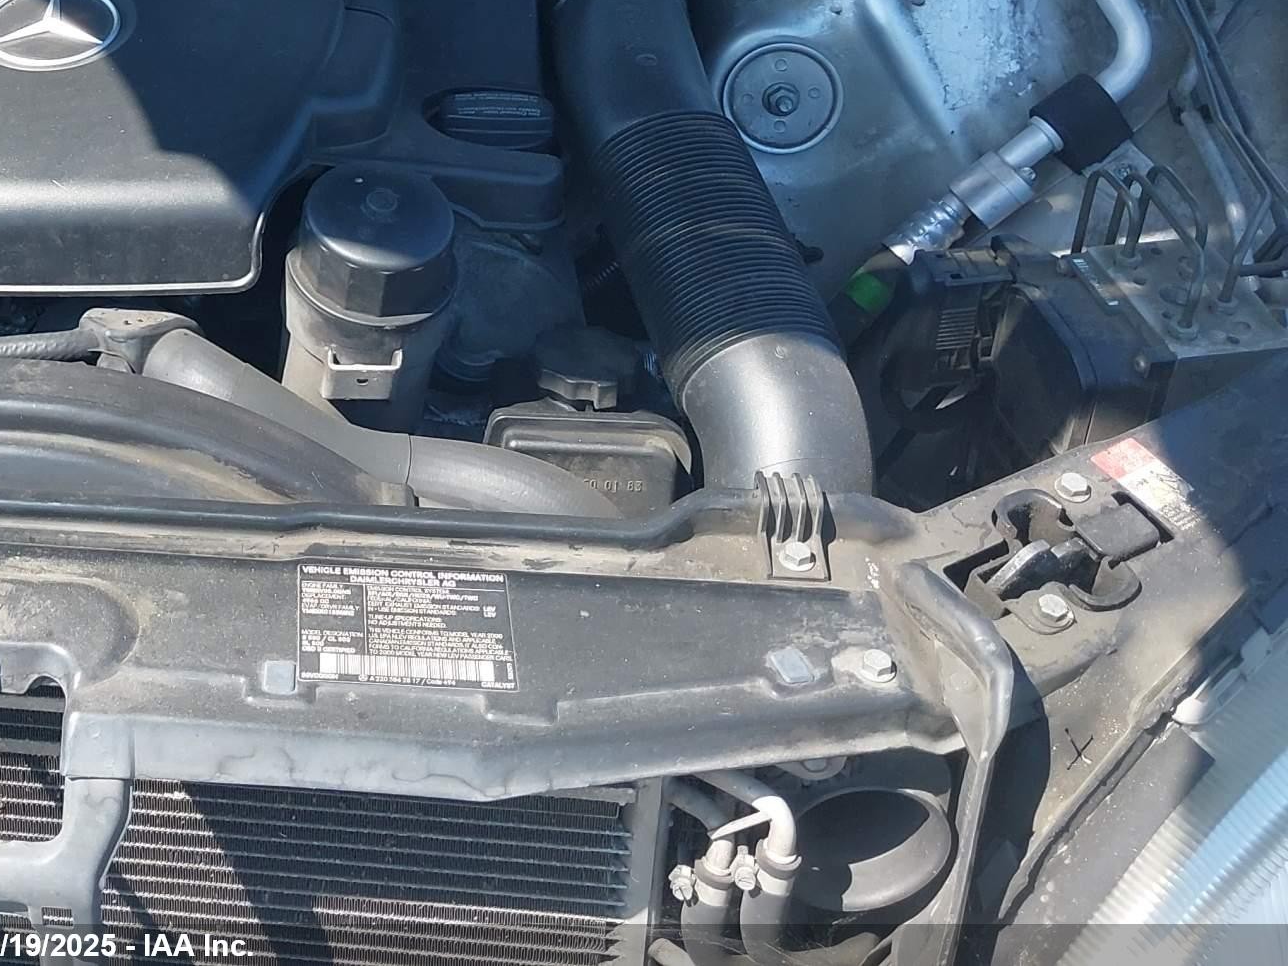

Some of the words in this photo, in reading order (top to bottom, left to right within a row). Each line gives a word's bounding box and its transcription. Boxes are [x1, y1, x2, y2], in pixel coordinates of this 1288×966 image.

[302, 566, 341, 574] VEHICLE
[343, 567, 389, 577] EMISSION
[390, 570, 436, 579] CONTROL
[438, 572, 504, 582] INFORMATION
[350, 575, 440, 586] DAIMLERCHRYSLER
